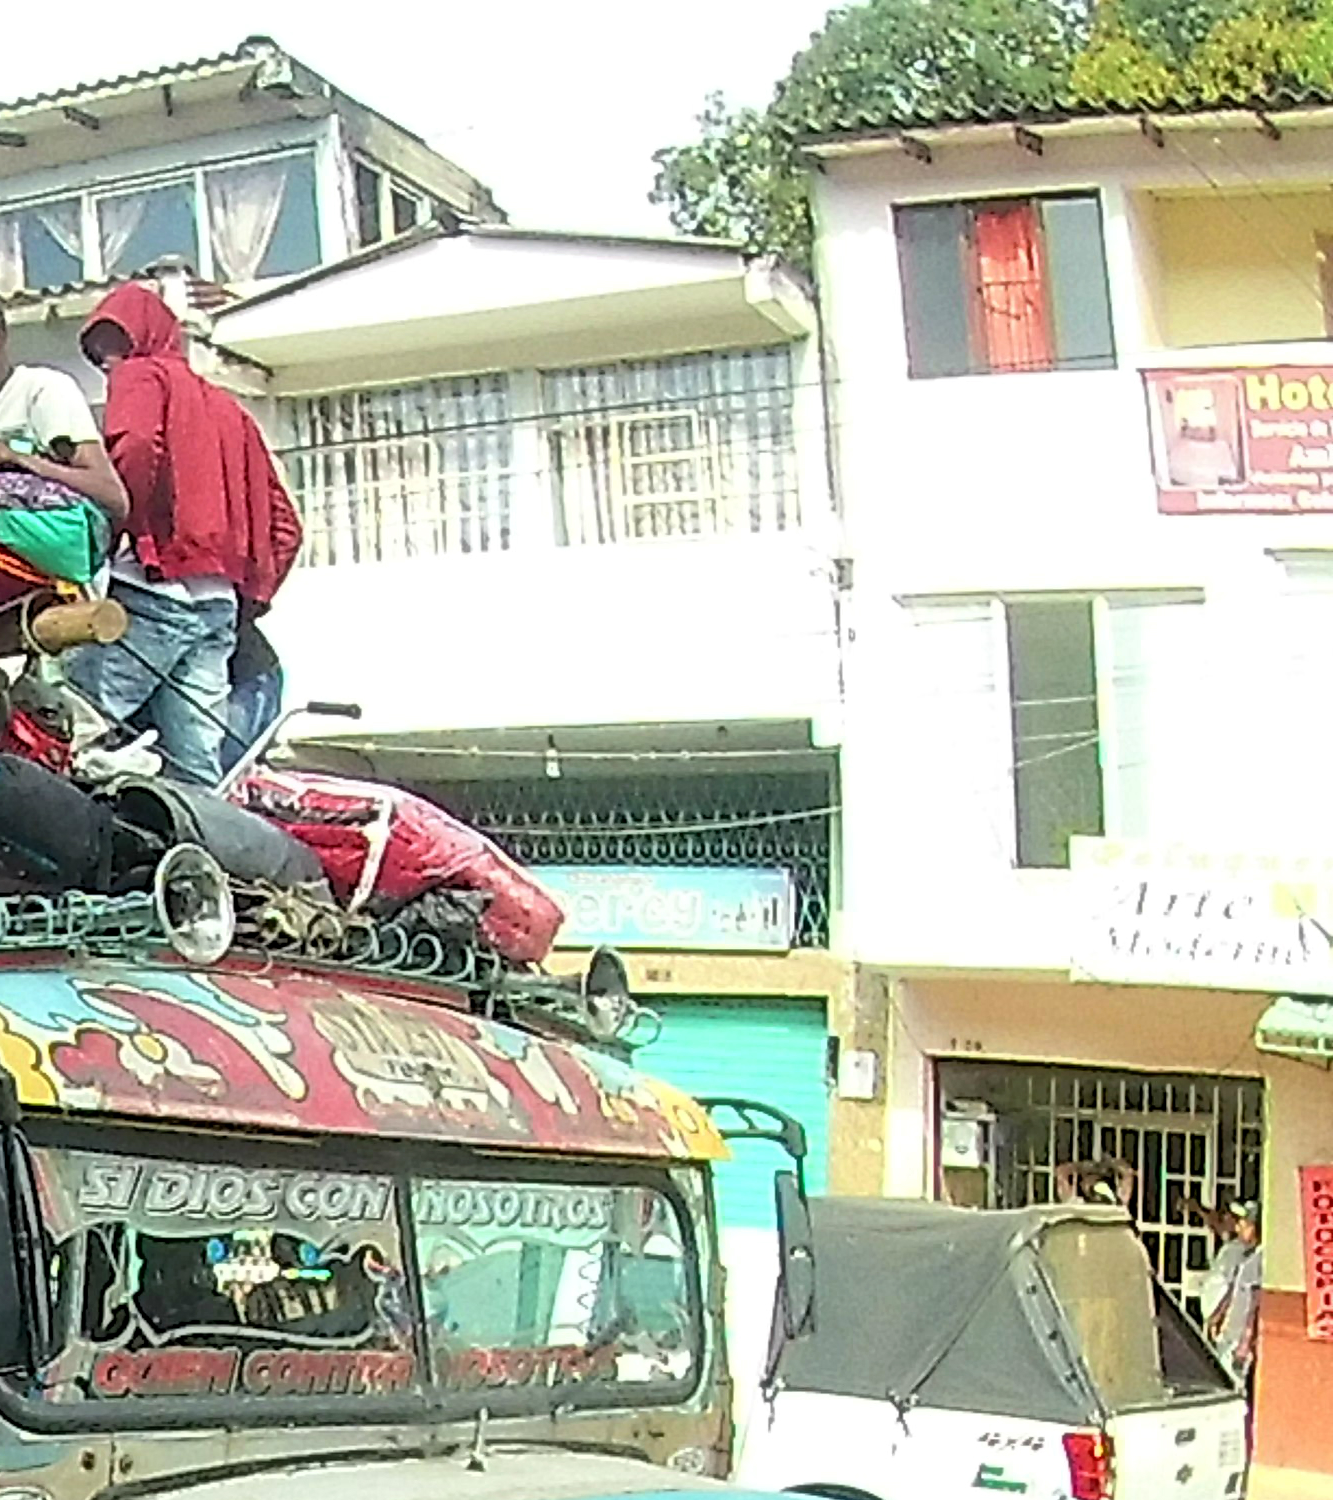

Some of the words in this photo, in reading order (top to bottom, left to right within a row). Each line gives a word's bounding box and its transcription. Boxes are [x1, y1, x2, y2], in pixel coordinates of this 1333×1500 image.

[80, 1161, 141, 1213] SI
[144, 1166, 281, 1221] DIOS
[283, 1170, 396, 1222] CON
[416, 1185, 614, 1232] NOSOTROS
